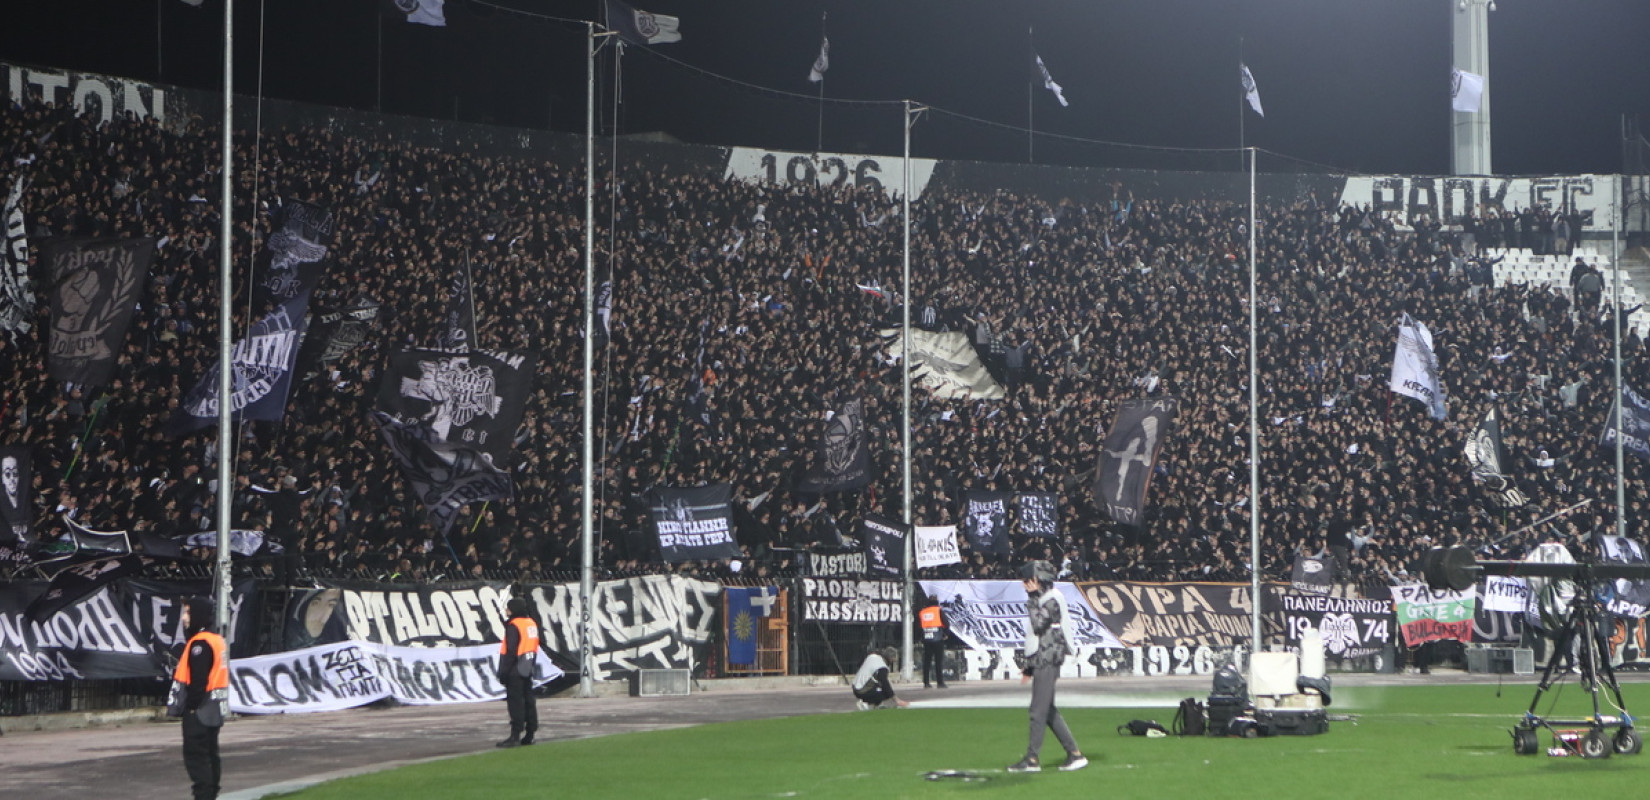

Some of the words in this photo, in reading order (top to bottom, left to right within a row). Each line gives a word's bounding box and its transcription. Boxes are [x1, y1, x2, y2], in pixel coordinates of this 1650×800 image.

[760, 153, 882, 198] 1926
[1372, 177, 1506, 226] PAOK
[803, 578, 857, 598] PAOK
[1086, 583, 1216, 615] ΘΥΡΑ
[1230, 587, 1253, 614] 4
[343, 585, 510, 647] PTALOFO
[805, 600, 903, 623] KASSANDR
[1284, 595, 1392, 615] ΠΑΝΕΛΛΗΝΙΟΣ
[1406, 603, 1449, 620] GATE
[1453, 604, 1466, 618] 4
[1288, 616, 1312, 641] 19
[1362, 619, 1389, 643] 74
[7, 651, 85, 681] 1994
[336, 662, 372, 682] ΓΙΑ
[965, 649, 1098, 681] PAK
[1131, 645, 1216, 677] 1926
